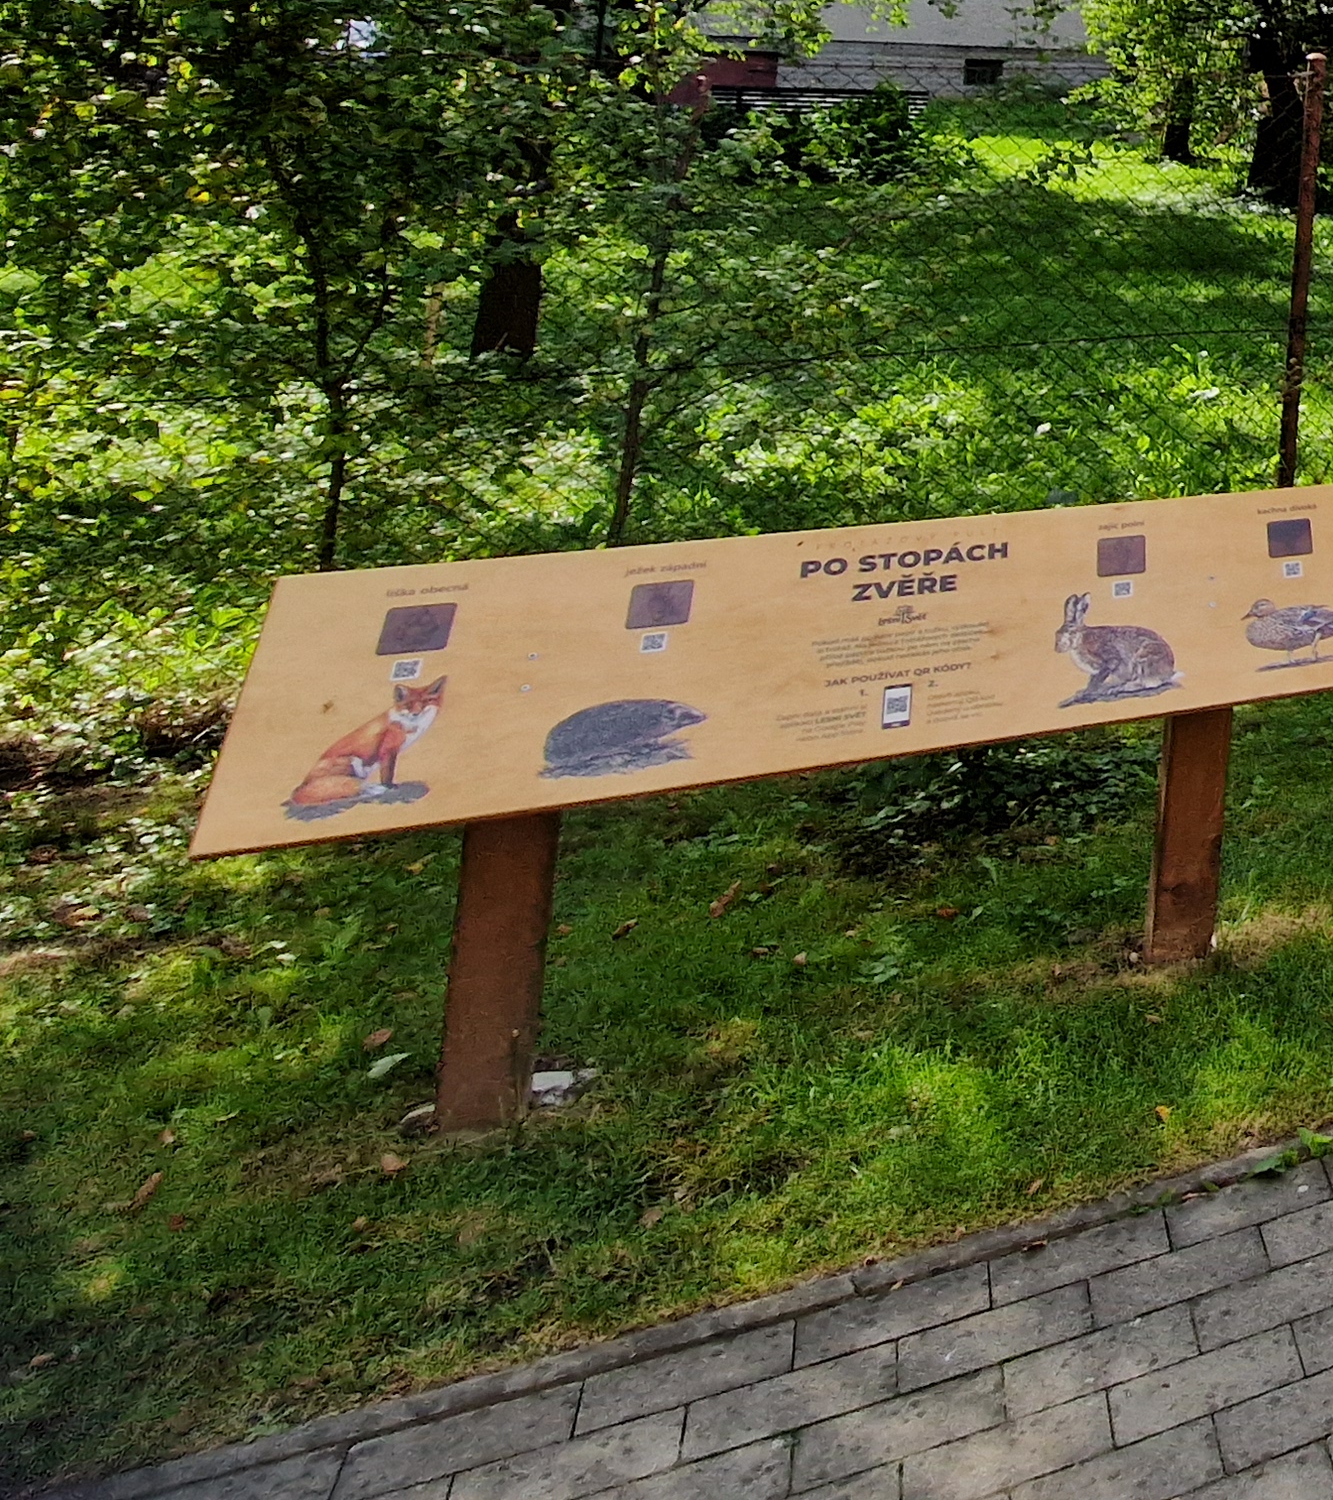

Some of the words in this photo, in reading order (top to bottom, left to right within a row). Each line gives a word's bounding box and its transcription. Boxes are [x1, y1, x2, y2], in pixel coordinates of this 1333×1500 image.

[800, 557, 848, 578] PO
[858, 541, 1009, 572] STOPÁCH
[851, 572, 957, 601] ZVĚŘE
[824, 678, 848, 688] JAK
[851, 669, 910, 684] POUŽÍVAT
[914, 667, 931, 677] QR
[934, 662, 972, 674] KÓDY?
